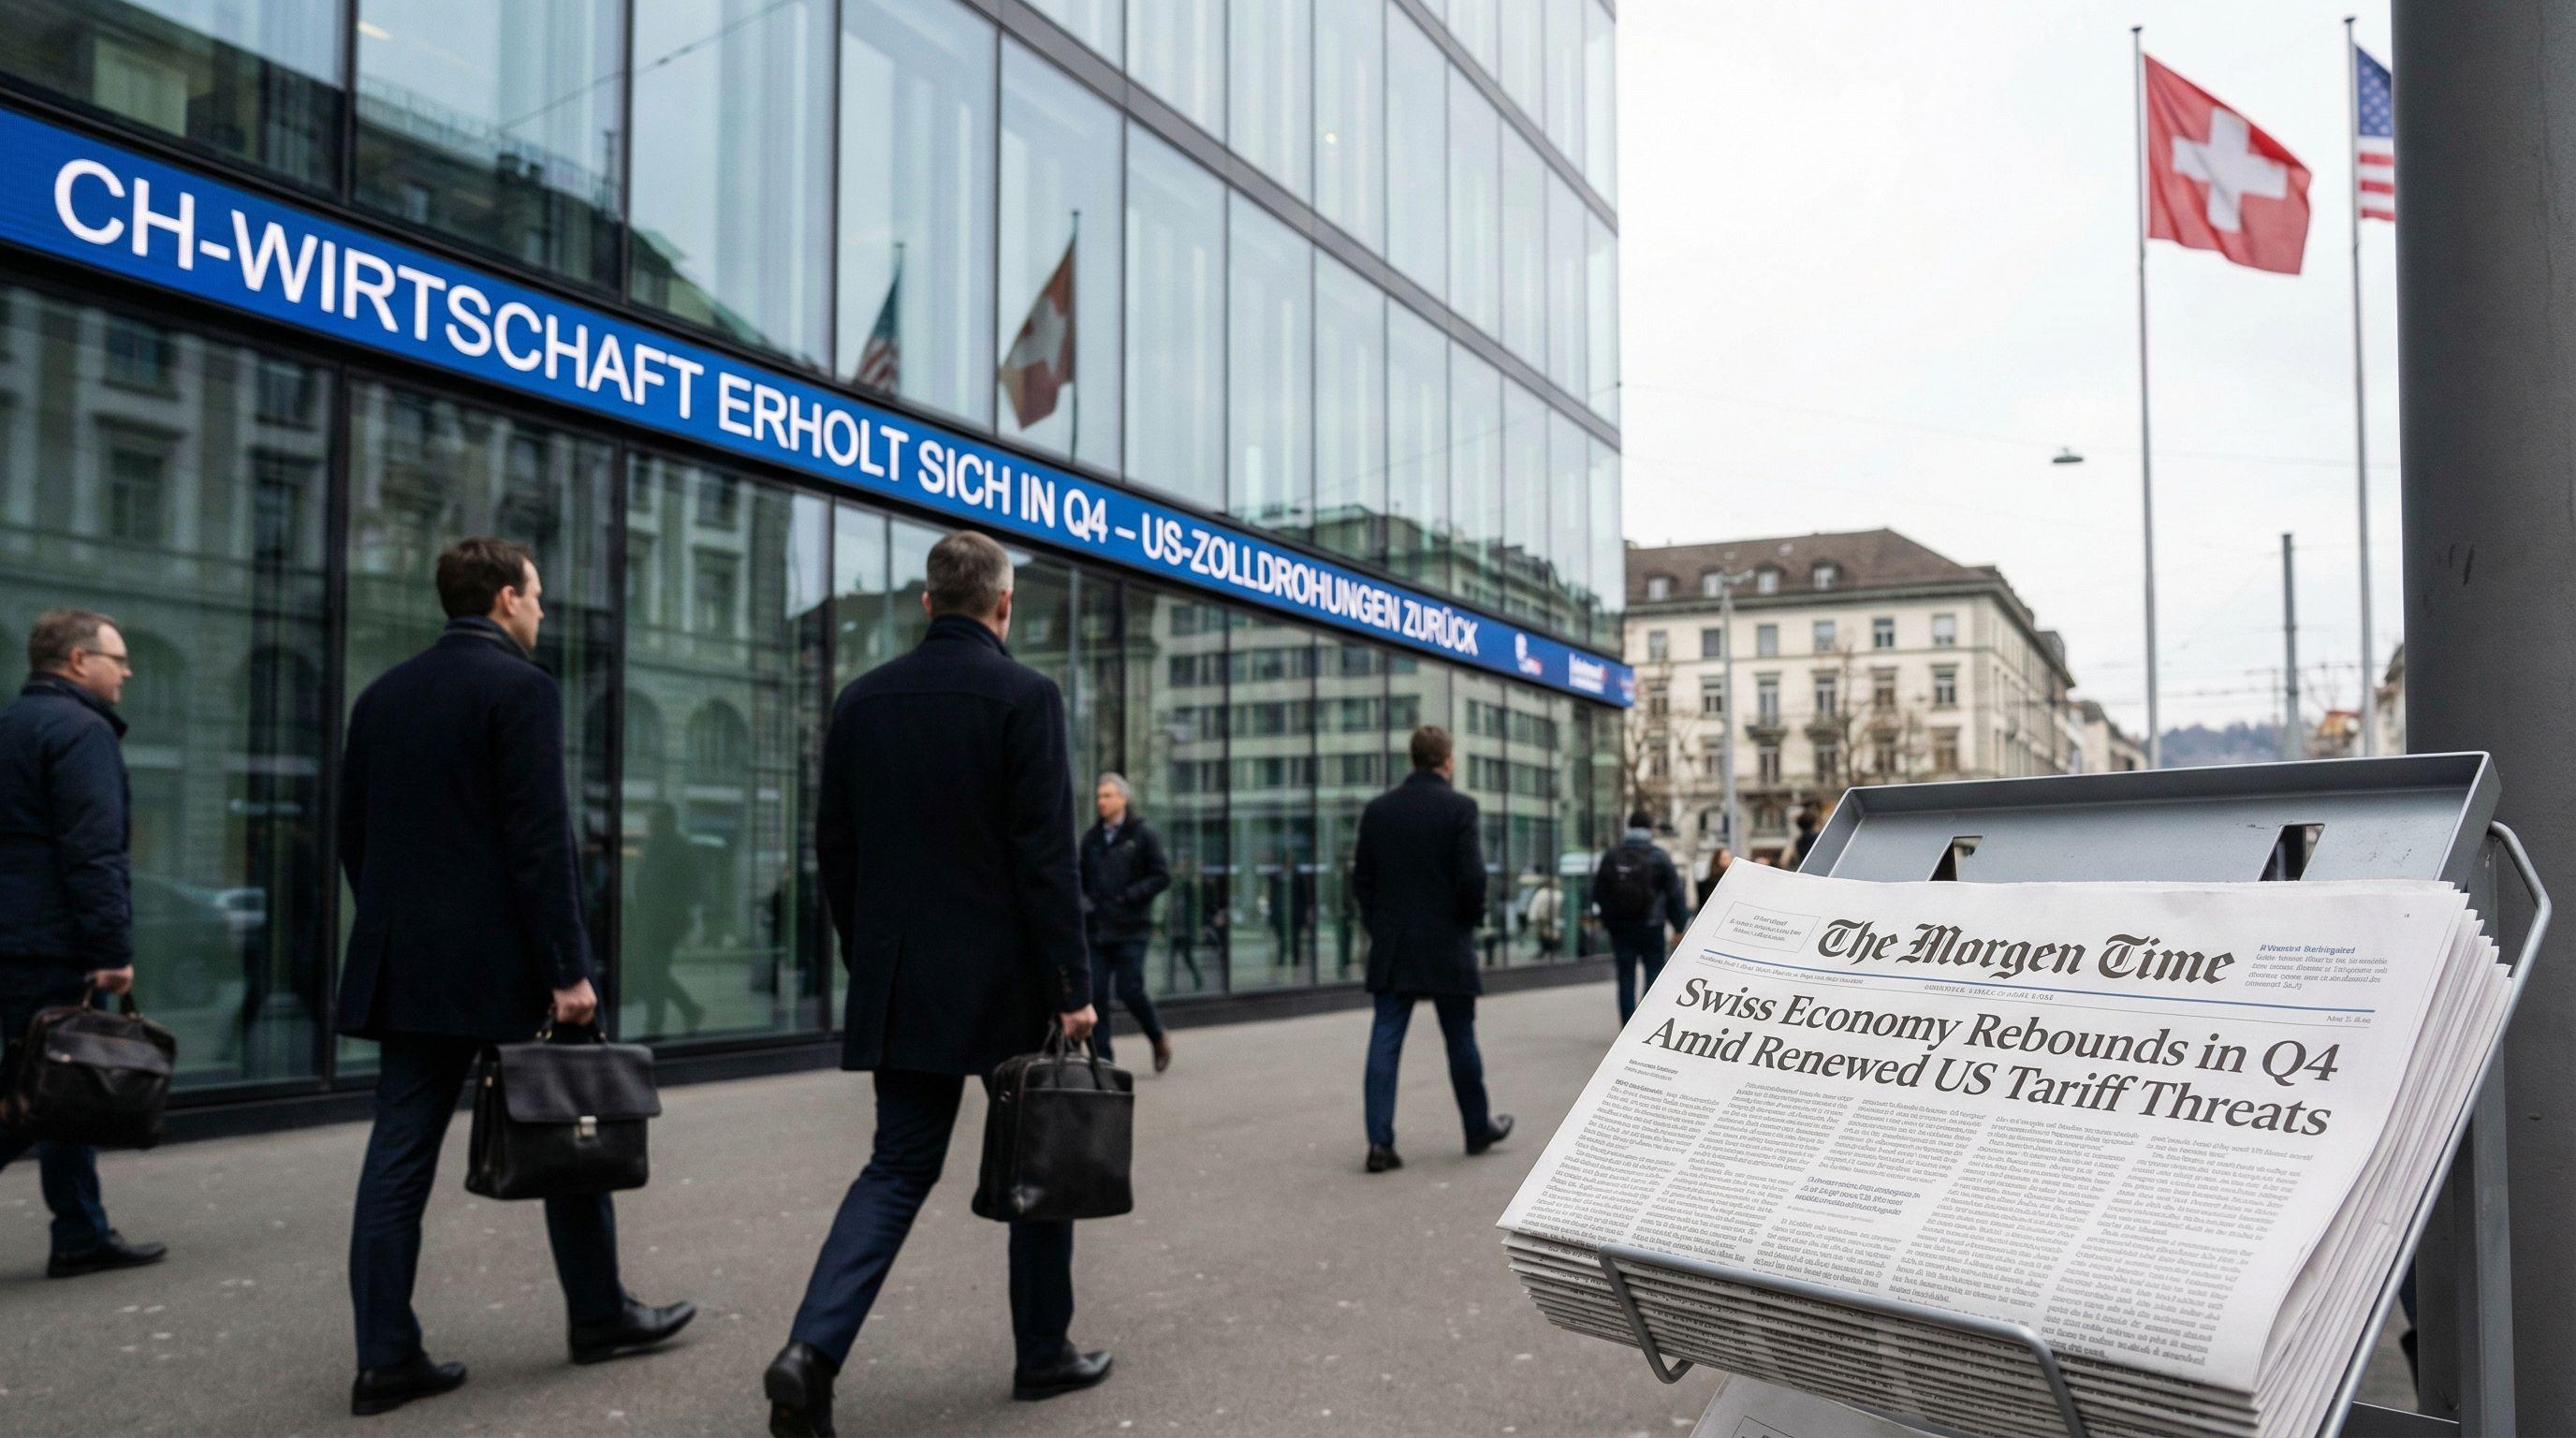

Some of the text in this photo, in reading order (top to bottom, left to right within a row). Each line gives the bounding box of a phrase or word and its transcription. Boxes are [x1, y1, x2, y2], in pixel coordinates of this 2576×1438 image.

[54, 158, 704, 419] CH-WIRTSCHAFT
[718, 372, 910, 481] ERHOLT
[917, 440, 1011, 515] SICH
[1020, 473, 1056, 528] IN
[1062, 488, 1108, 544] Q4
[1141, 512, 1401, 633] US-ZOLLDROHUNGEN
[1402, 599, 1479, 655] ZURÜCK
[1817, 918, 1899, 966] The
[1897, 923, 2086, 980] Morgen
[2098, 933, 2235, 985] Time
[1642, 1017, 2332, 1136] Amid Renewed US Tariff Threats
[1676, 977, 2340, 1087] Swiss Economy Rebounds in Q4
